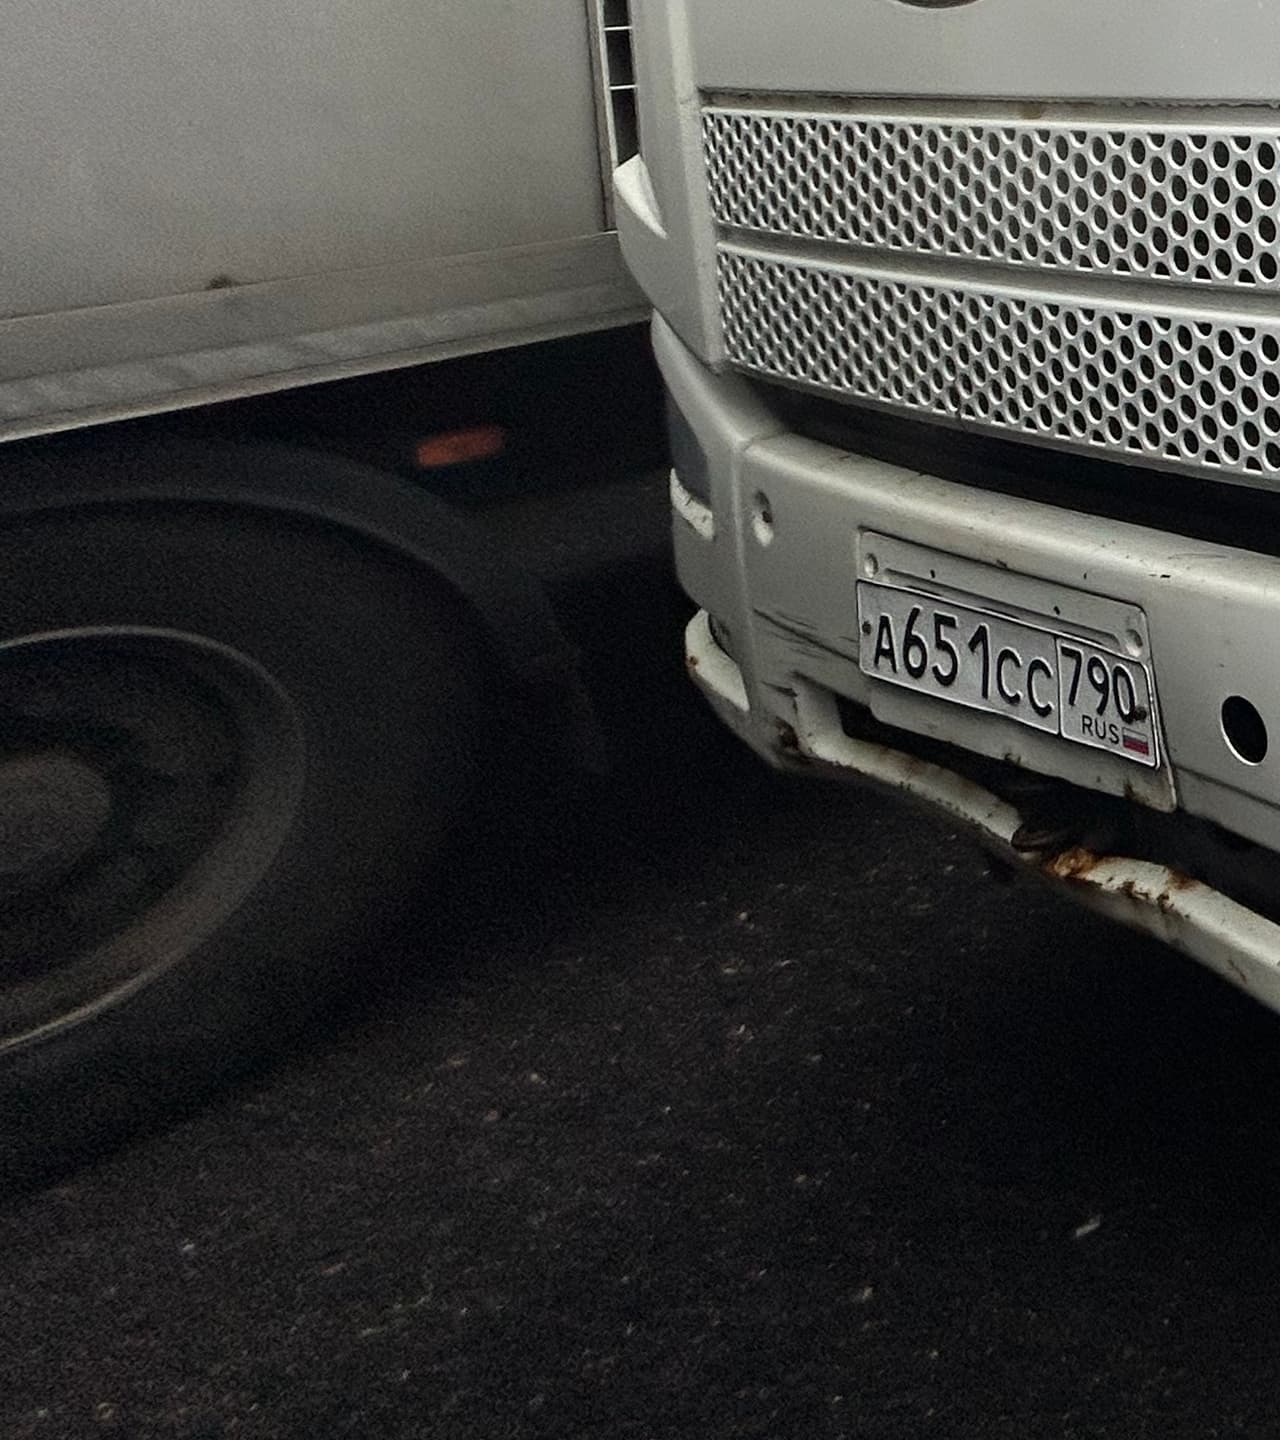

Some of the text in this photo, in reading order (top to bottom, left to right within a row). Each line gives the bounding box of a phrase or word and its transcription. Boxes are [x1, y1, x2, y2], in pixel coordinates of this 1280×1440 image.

[873, 605, 1136, 724] A651CC 790
[1081, 714, 1120, 746] RUS
